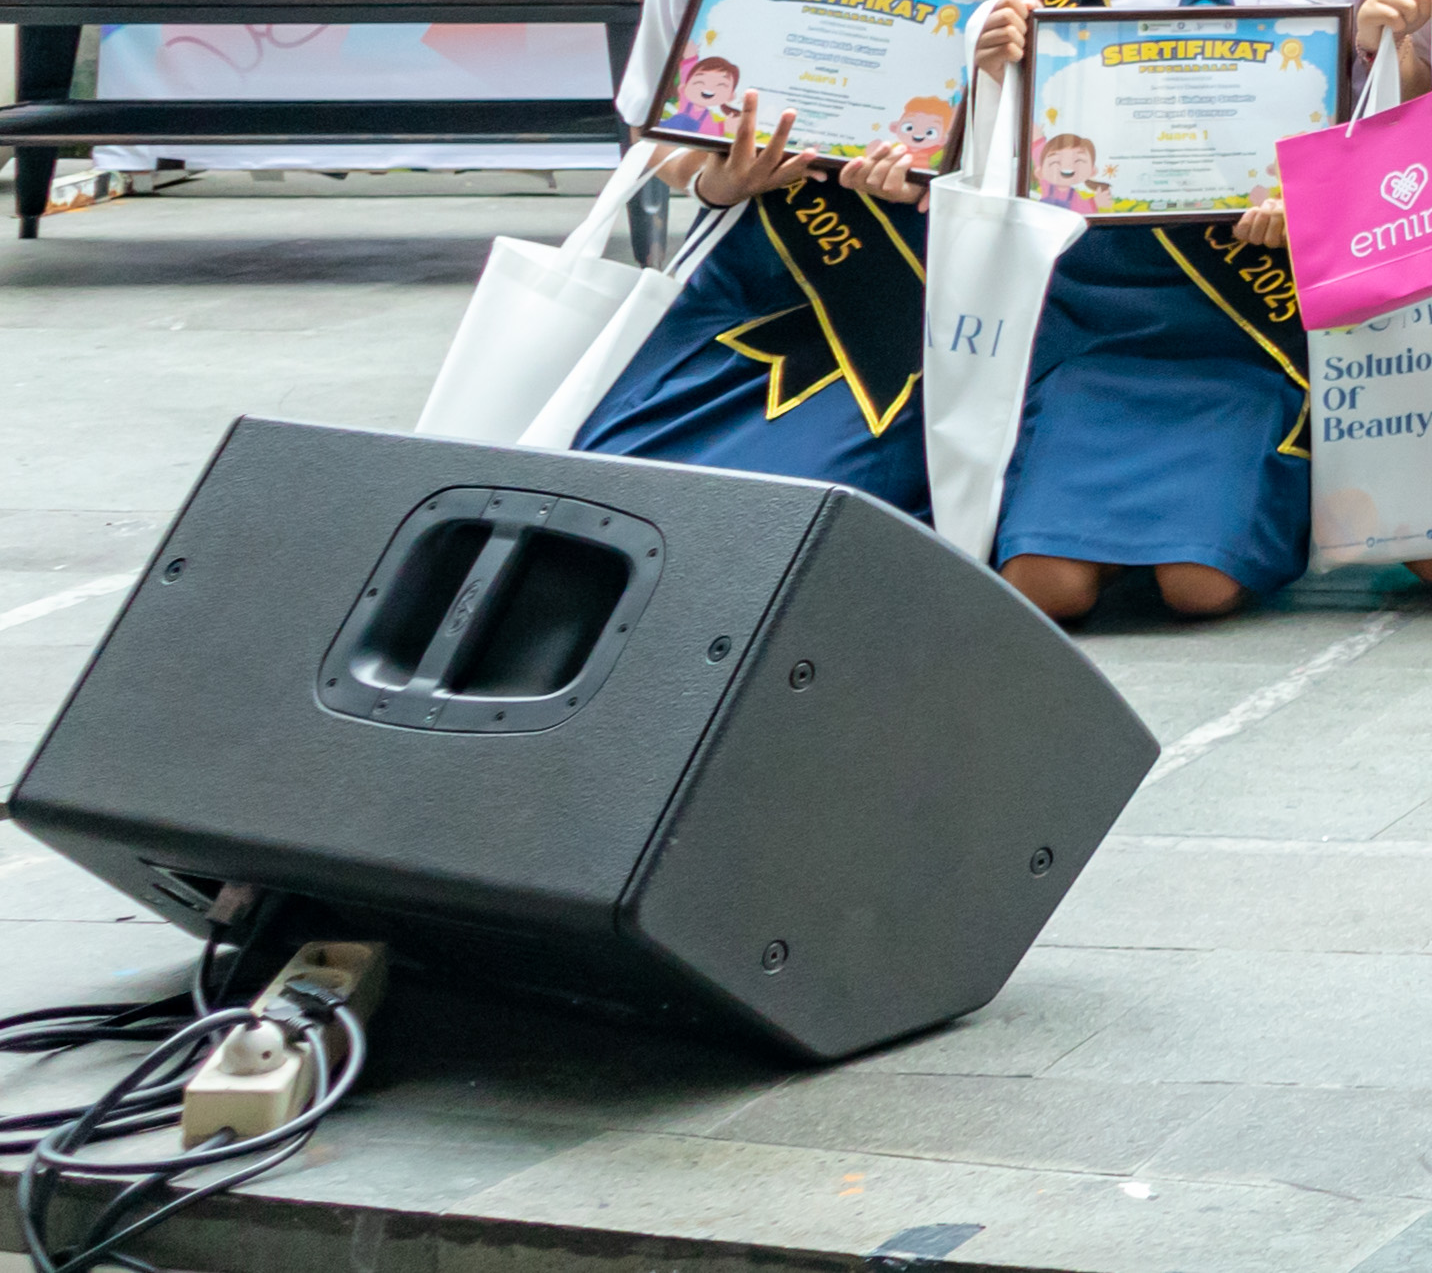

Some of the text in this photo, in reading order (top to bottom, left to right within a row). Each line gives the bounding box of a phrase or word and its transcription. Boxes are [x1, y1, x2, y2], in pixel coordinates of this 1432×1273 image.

[1102, 38, 1274, 67] SERTIFIKAT
[795, 197, 863, 265] 2025
[1238, 255, 1298, 322] 2025
[1323, 386, 1365, 411] Of
